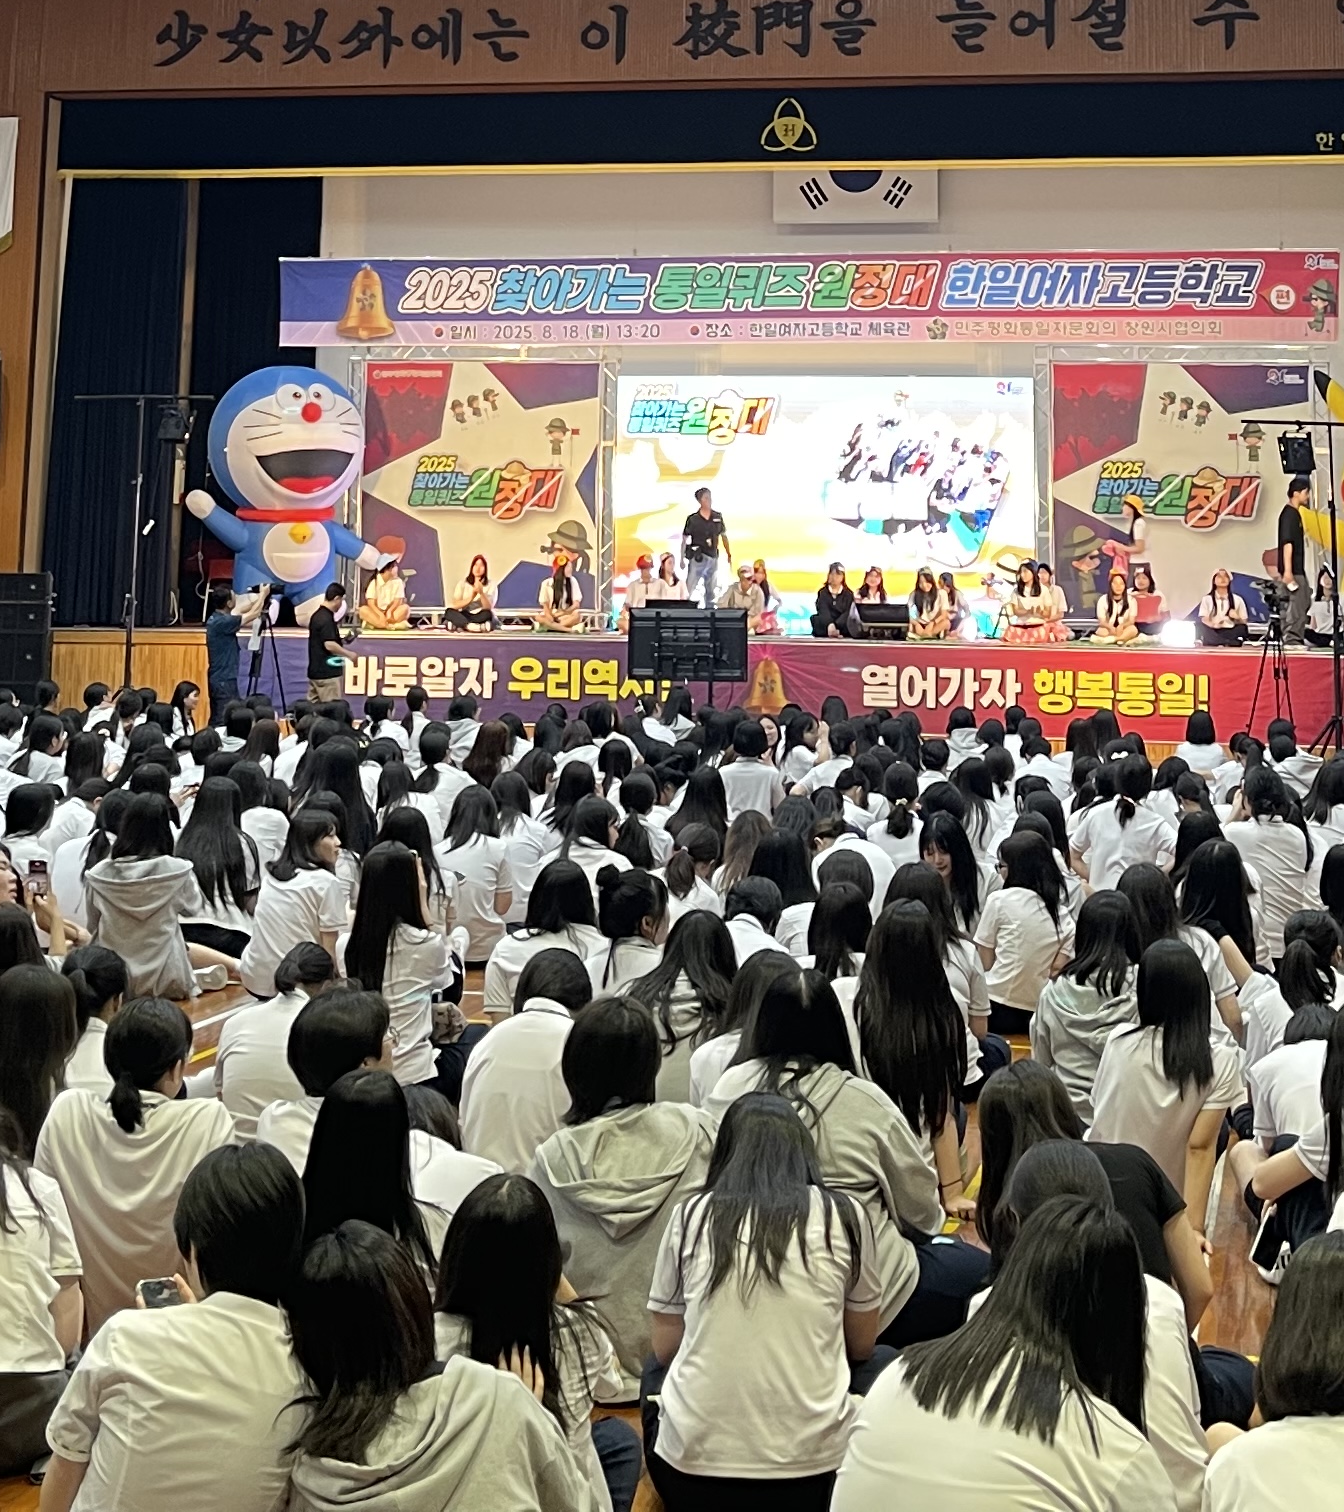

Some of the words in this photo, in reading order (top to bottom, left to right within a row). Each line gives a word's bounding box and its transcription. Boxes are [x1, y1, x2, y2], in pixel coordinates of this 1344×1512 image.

[154, 5, 530, 69] 少女以外에는
[580, 4, 629, 65] 이
[399, 266, 494, 313] 2025
[492, 264, 649, 313] 찾아가는
[653, 262, 810, 311] 통일퀴즈
[808, 261, 940, 311] 원정대
[939, 258, 1265, 310] 한일여자고등학교
[1275, 289, 1291, 305] 편
[450, 325, 479, 340] 일시
[616, 324, 660, 339] 13:20
[706, 323, 733, 339] 장소
[749, 323, 862, 338] 한일여자고등학교
[868, 321, 911, 337] 체육관
[955, 320, 1117, 337] 민주평화통일자문회의
[1126, 319, 1223, 336] 창원시협의회
[416, 455, 458, 473] 2025
[1100, 461, 1145, 479] 2025
[413, 472, 470, 490] 찾아가는
[1097, 478, 1161, 496] 찾아가는
[464, 467, 563, 519] 원정대
[1154, 473, 1261, 527] 원정대
[344, 655, 498, 698] 바로알자
[861, 664, 1021, 710] 열어가자
[1032, 667, 1210, 716] 행복통일!
